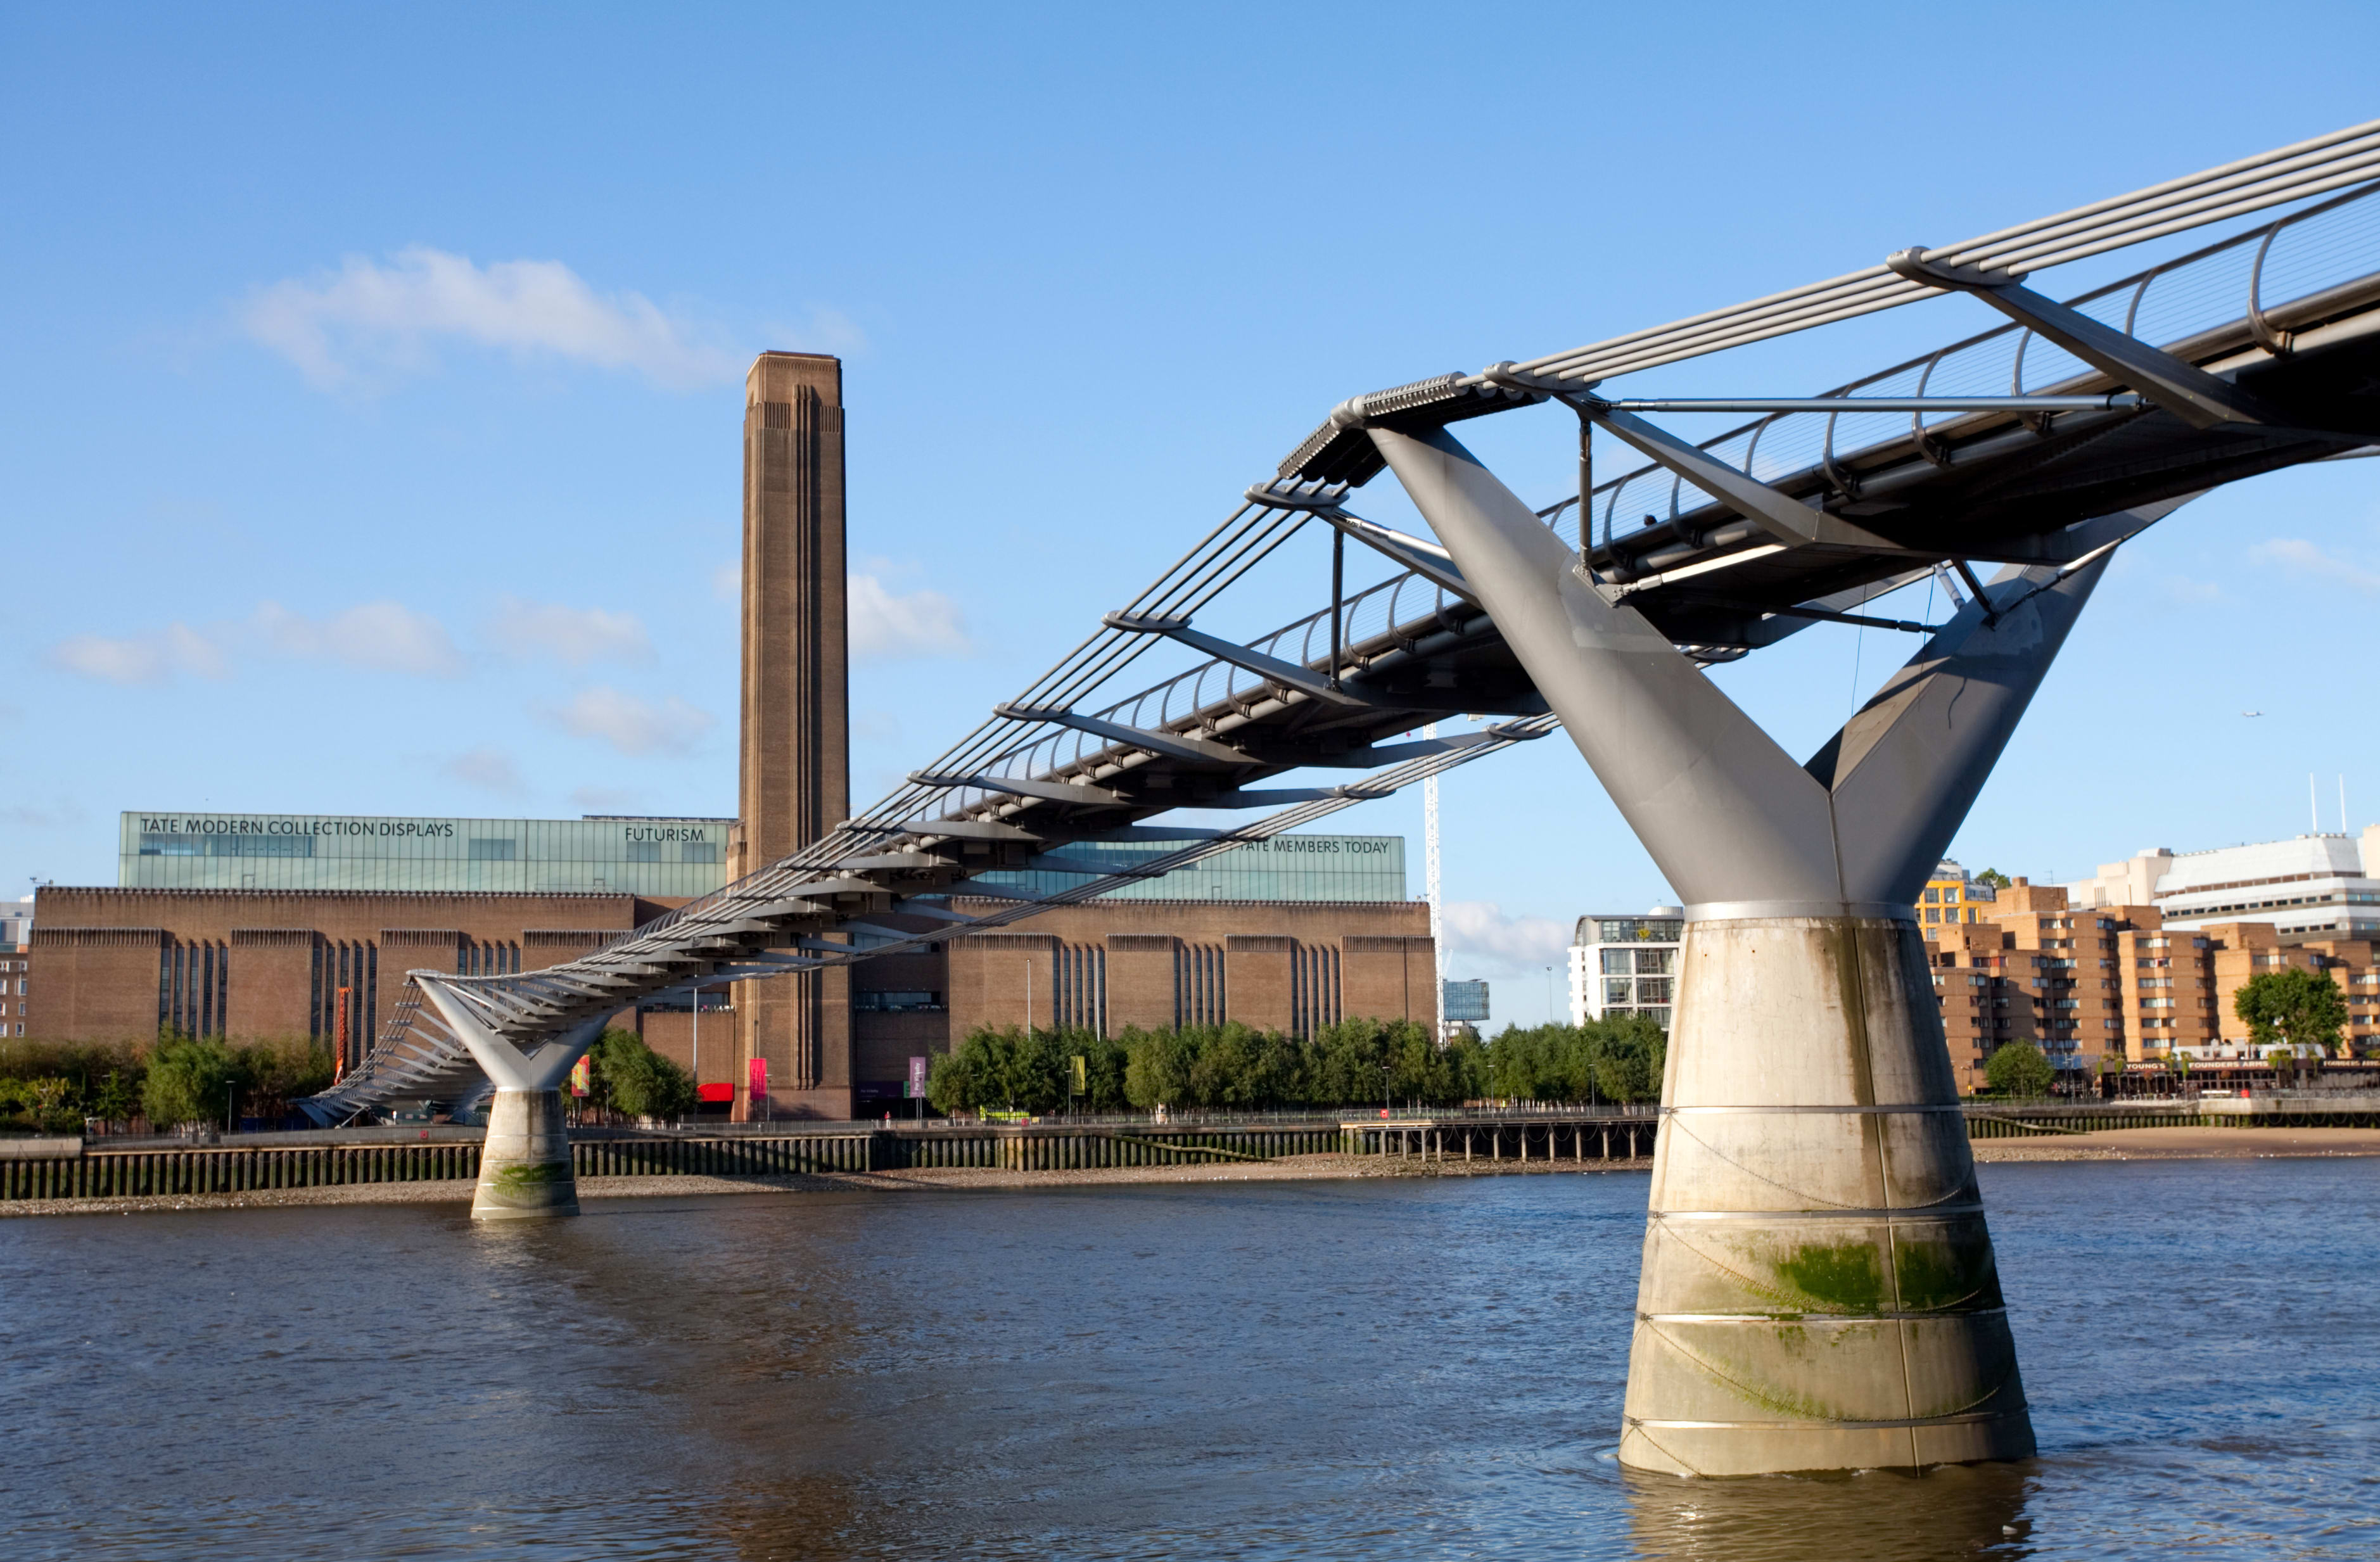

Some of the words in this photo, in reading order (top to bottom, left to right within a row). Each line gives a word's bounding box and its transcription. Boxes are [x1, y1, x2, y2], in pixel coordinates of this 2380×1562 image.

[141, 819, 179, 833] TATE
[186, 820, 263, 834] MODERN
[269, 821, 374, 836] COLLECTION
[380, 823, 454, 837] DISPLAYS
[625, 827, 704, 842] FUTURISM
[1274, 841, 1340, 853] MEMBERS
[1344, 841, 1389, 854] TODAY
[2189, 1061, 2240, 1069] FOUNDERS
